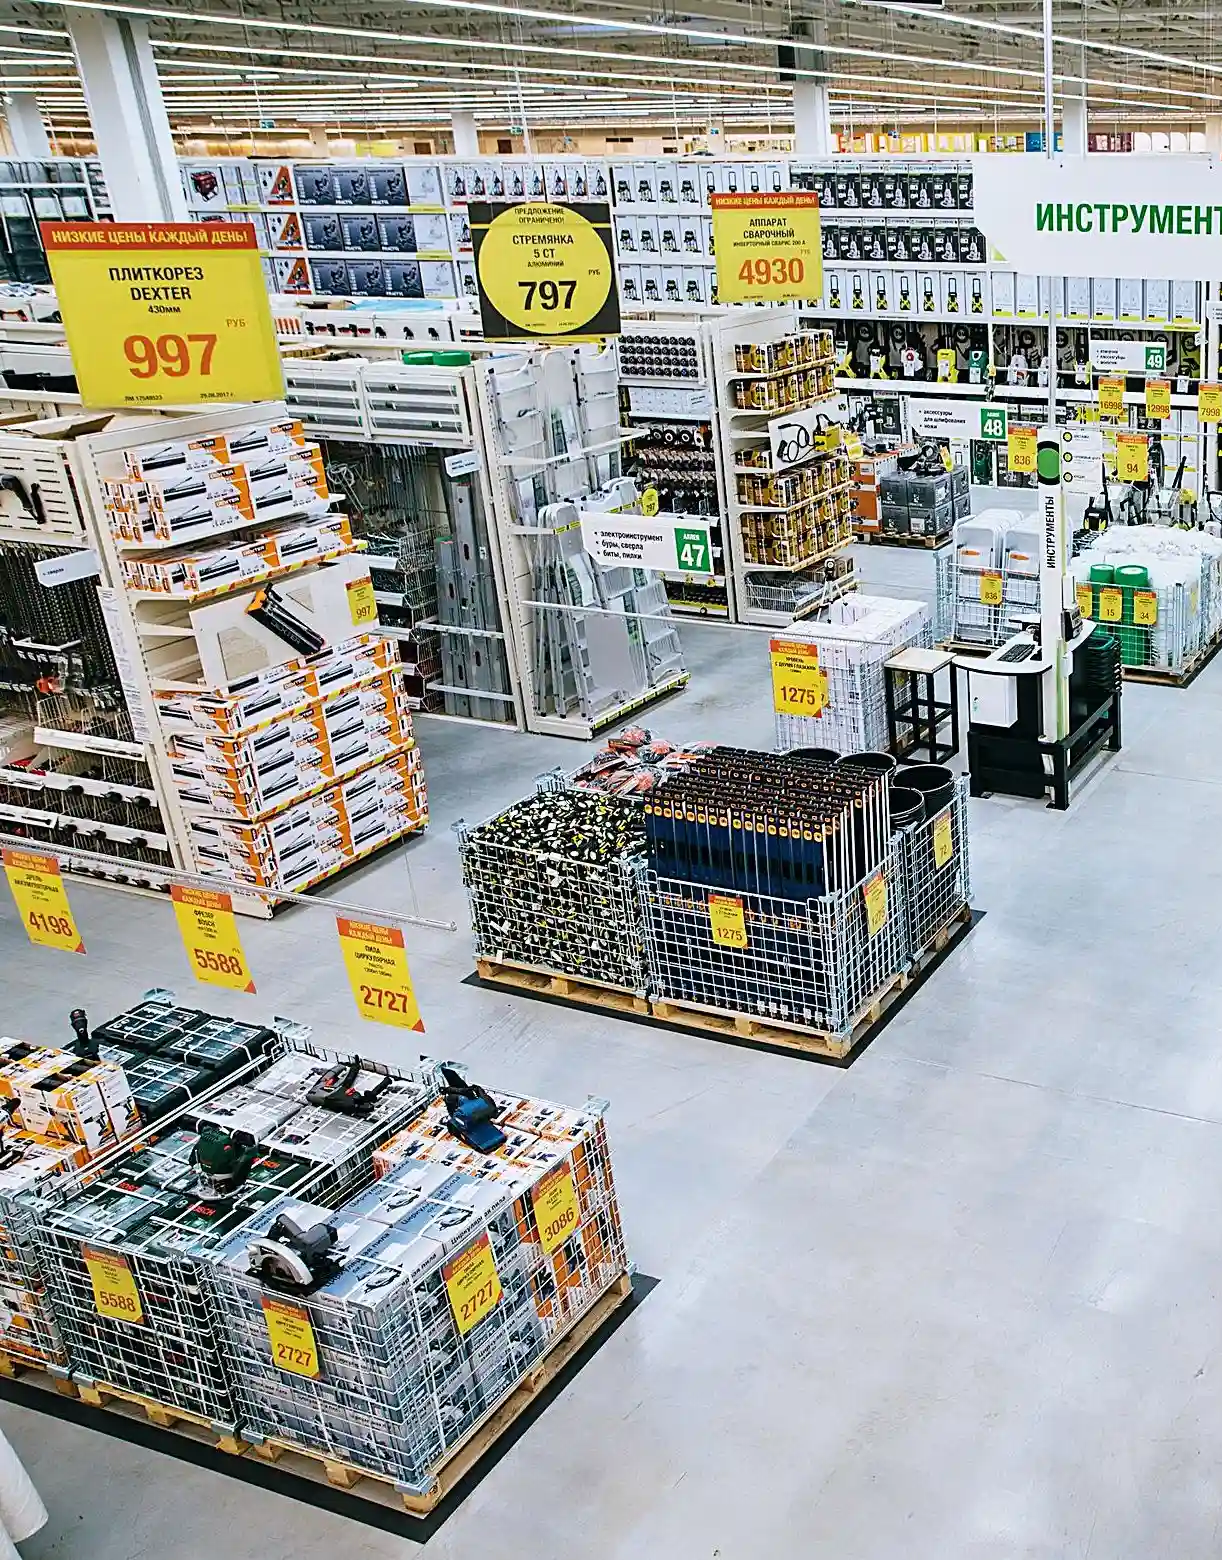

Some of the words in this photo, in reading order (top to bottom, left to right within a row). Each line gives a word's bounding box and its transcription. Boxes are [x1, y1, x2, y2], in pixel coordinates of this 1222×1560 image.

[744, 197, 762, 206] ЦЕНЫ
[764, 197, 794, 205] КАЖДЫЙ
[514, 207, 565, 215] ПРЕДЛОЖЕНИЕ
[518, 216, 565, 225] ОГРАНИЧЕНО!
[750, 218, 787, 227] АППАРАТ
[52, 230, 107, 244] НИЗКИЕ
[109, 231, 146, 246] ЦЕНЫ
[150, 230, 208, 244] КАЖДЫЙ
[212, 231, 248, 244] ДЕНЬ!
[512, 234, 574, 245] СТРЕМЯНКА
[744, 228, 794, 238] СВАРОЧНЫЙ
[533, 248, 540, 259] 5
[543, 248, 555, 259] СТ
[109, 267, 204, 281] ПЛИТКОРЕЗ
[739, 258, 804, 285] 4930
[131, 287, 192, 300] DEXTER
[518, 280, 577, 311] 797
[148, 305, 181, 314] 430мм
[226, 318, 246, 328] РУБ
[124, 334, 217, 379] 997
[1147, 354, 1163, 368] 49
[1202, 408, 1220, 417] 7998
[983, 418, 1002, 436] 48
[1014, 456, 1030, 465] 836
[1127, 463, 1138, 473] 94
[600, 530, 663, 542] электроинструмент
[1046, 495, 1057, 569] ИНСТРУМЕНТЫ
[601, 540, 619, 550] буры,
[621, 542, 644, 551] сверла
[602, 549, 621, 559] биты,
[623, 551, 642, 560] пилки
[680, 545, 705, 568] 47
[984, 590, 998, 602] 836
[355, 604, 372, 618] 997
[1106, 608, 1115, 617] 15
[1140, 611, 1150, 621] 34
[781, 686, 815, 705] 1275
[29, 911, 73, 937] 4198
[717, 927, 743, 941] 1275
[193, 948, 243, 976] 5588
[360, 985, 408, 1013] 2727
[544, 1208, 575, 1242] 3086
[100, 1291, 136, 1313] 5588
[460, 1280, 495, 1321] 2727
[277, 1342, 311, 1367] 2727
